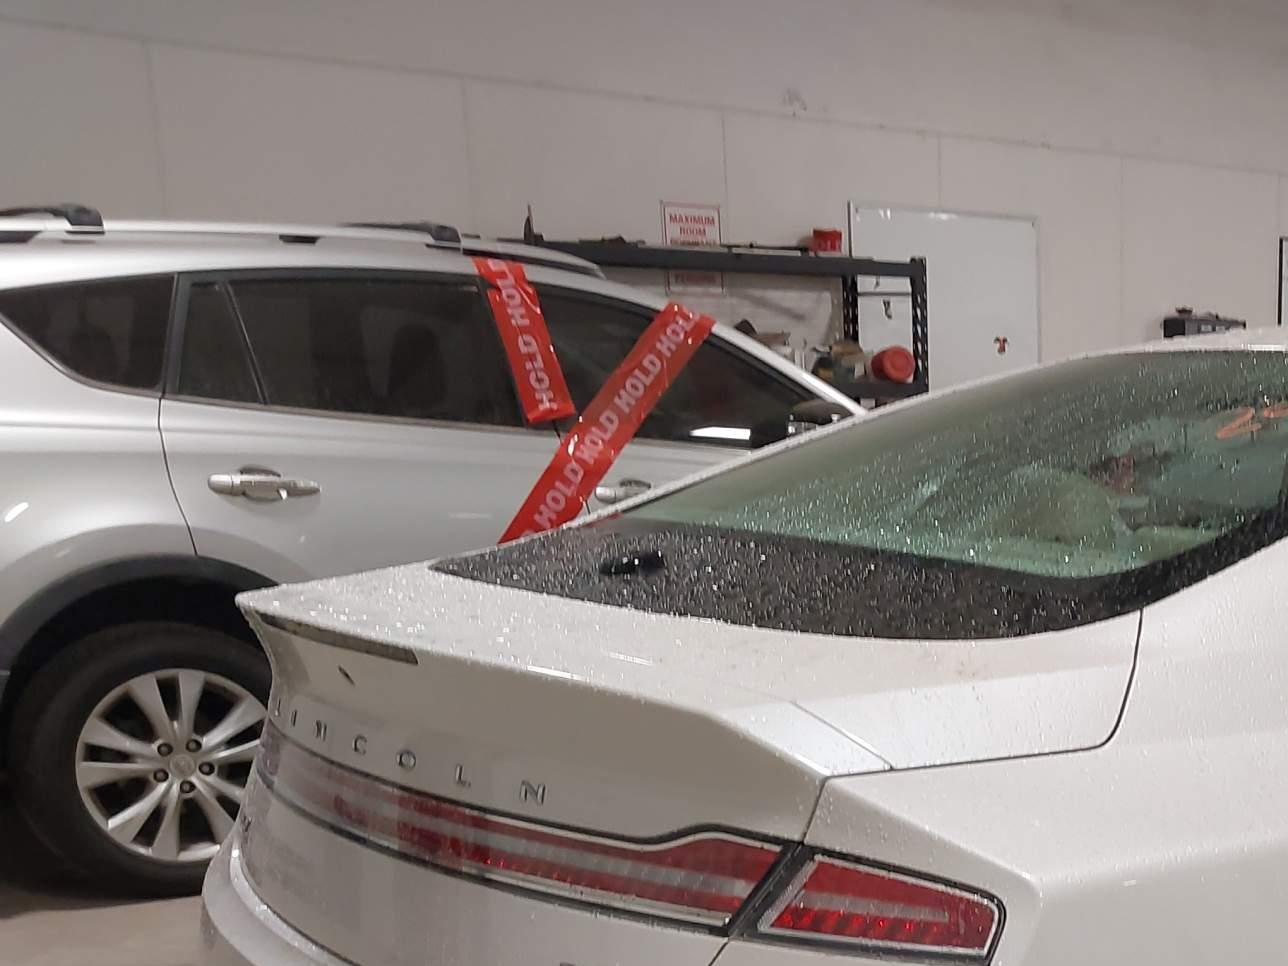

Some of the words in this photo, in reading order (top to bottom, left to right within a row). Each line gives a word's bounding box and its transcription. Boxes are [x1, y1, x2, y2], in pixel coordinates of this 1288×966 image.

[669, 213, 715, 225] MAXIMUM
[679, 226, 706, 236] ROOM
[517, 335, 557, 411] HOLD
[533, 460, 584, 528] HOLD
[576, 410, 620, 465] HOLD
[614, 353, 662, 414] HOLD
[272, 696, 547, 807] LINCOLN
